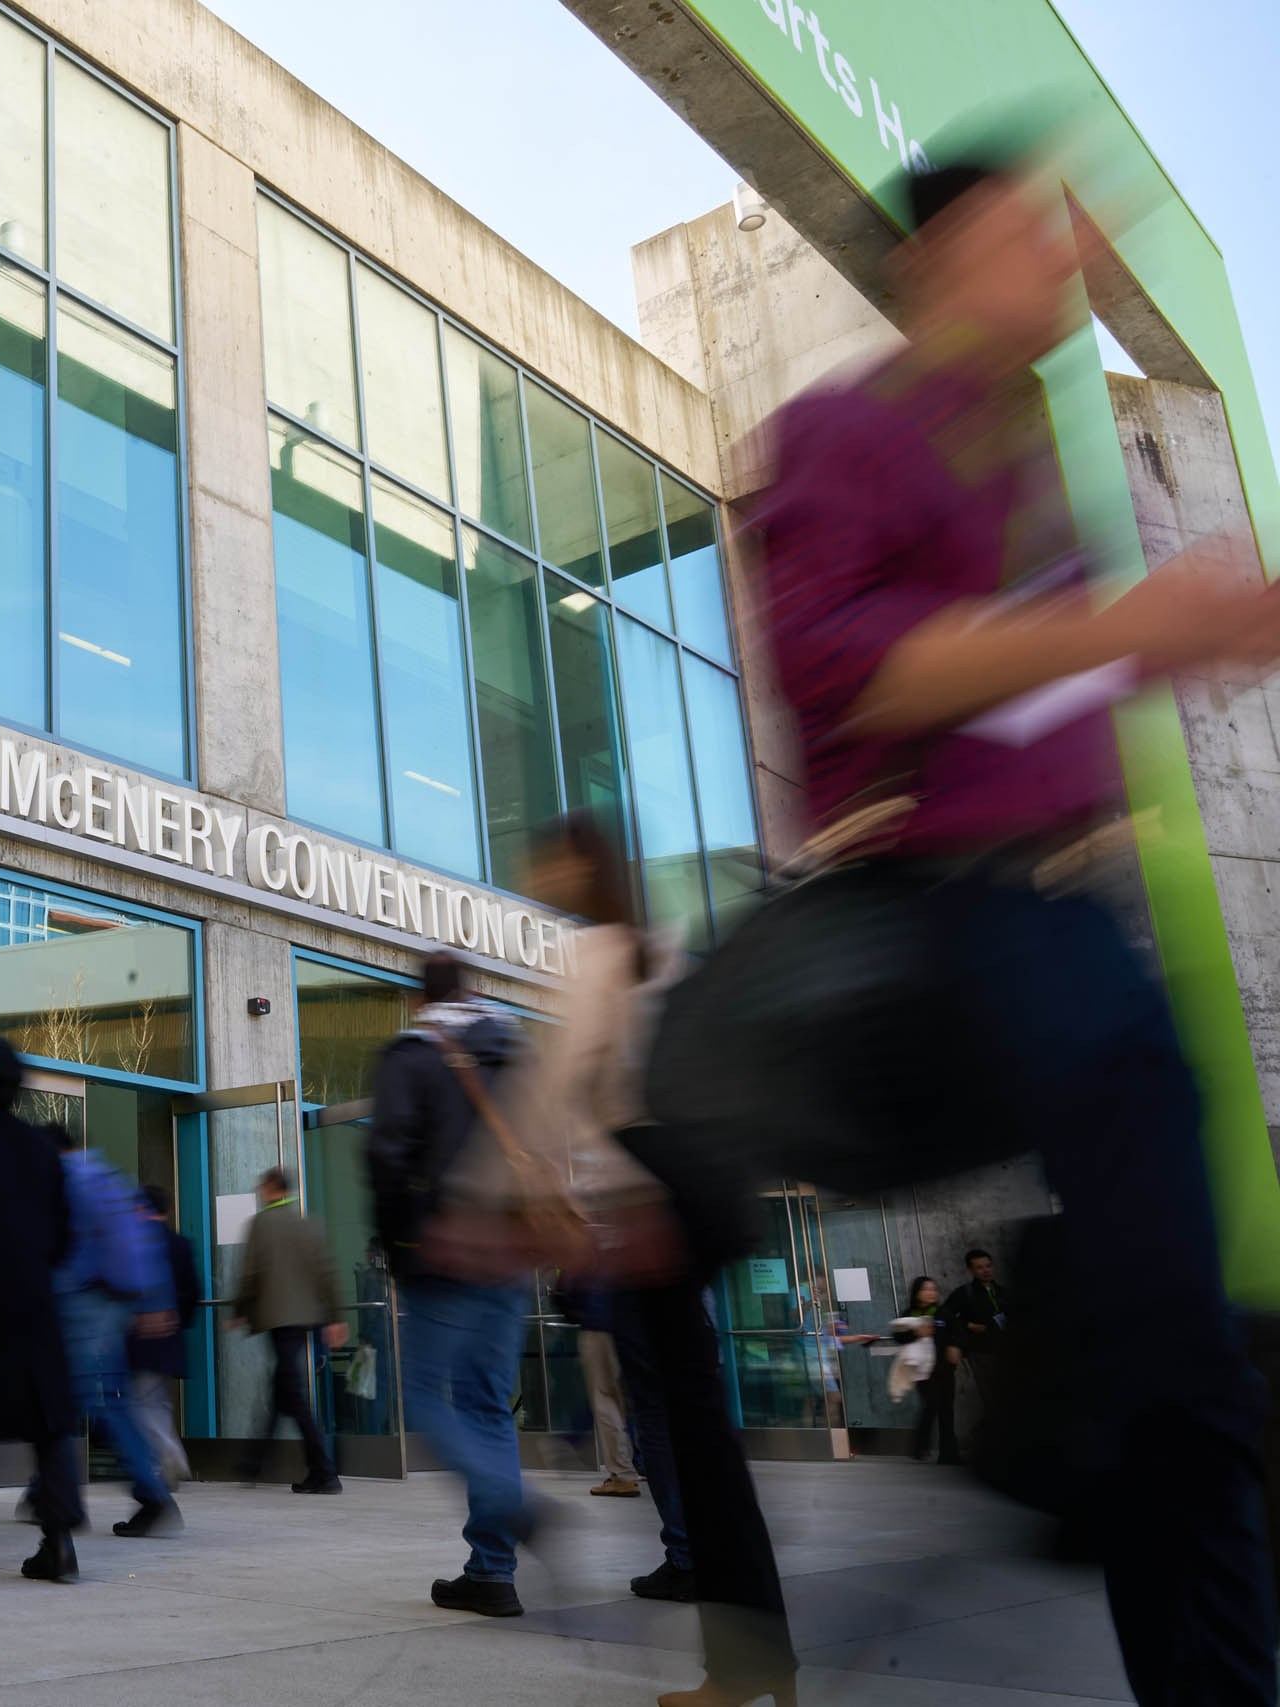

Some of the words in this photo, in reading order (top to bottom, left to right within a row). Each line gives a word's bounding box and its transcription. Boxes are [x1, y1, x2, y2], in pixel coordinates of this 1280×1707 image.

[759, 0, 863, 118] arts
[246, 825, 506, 959] CONVENTION
[504, 910, 577, 977] CEN
